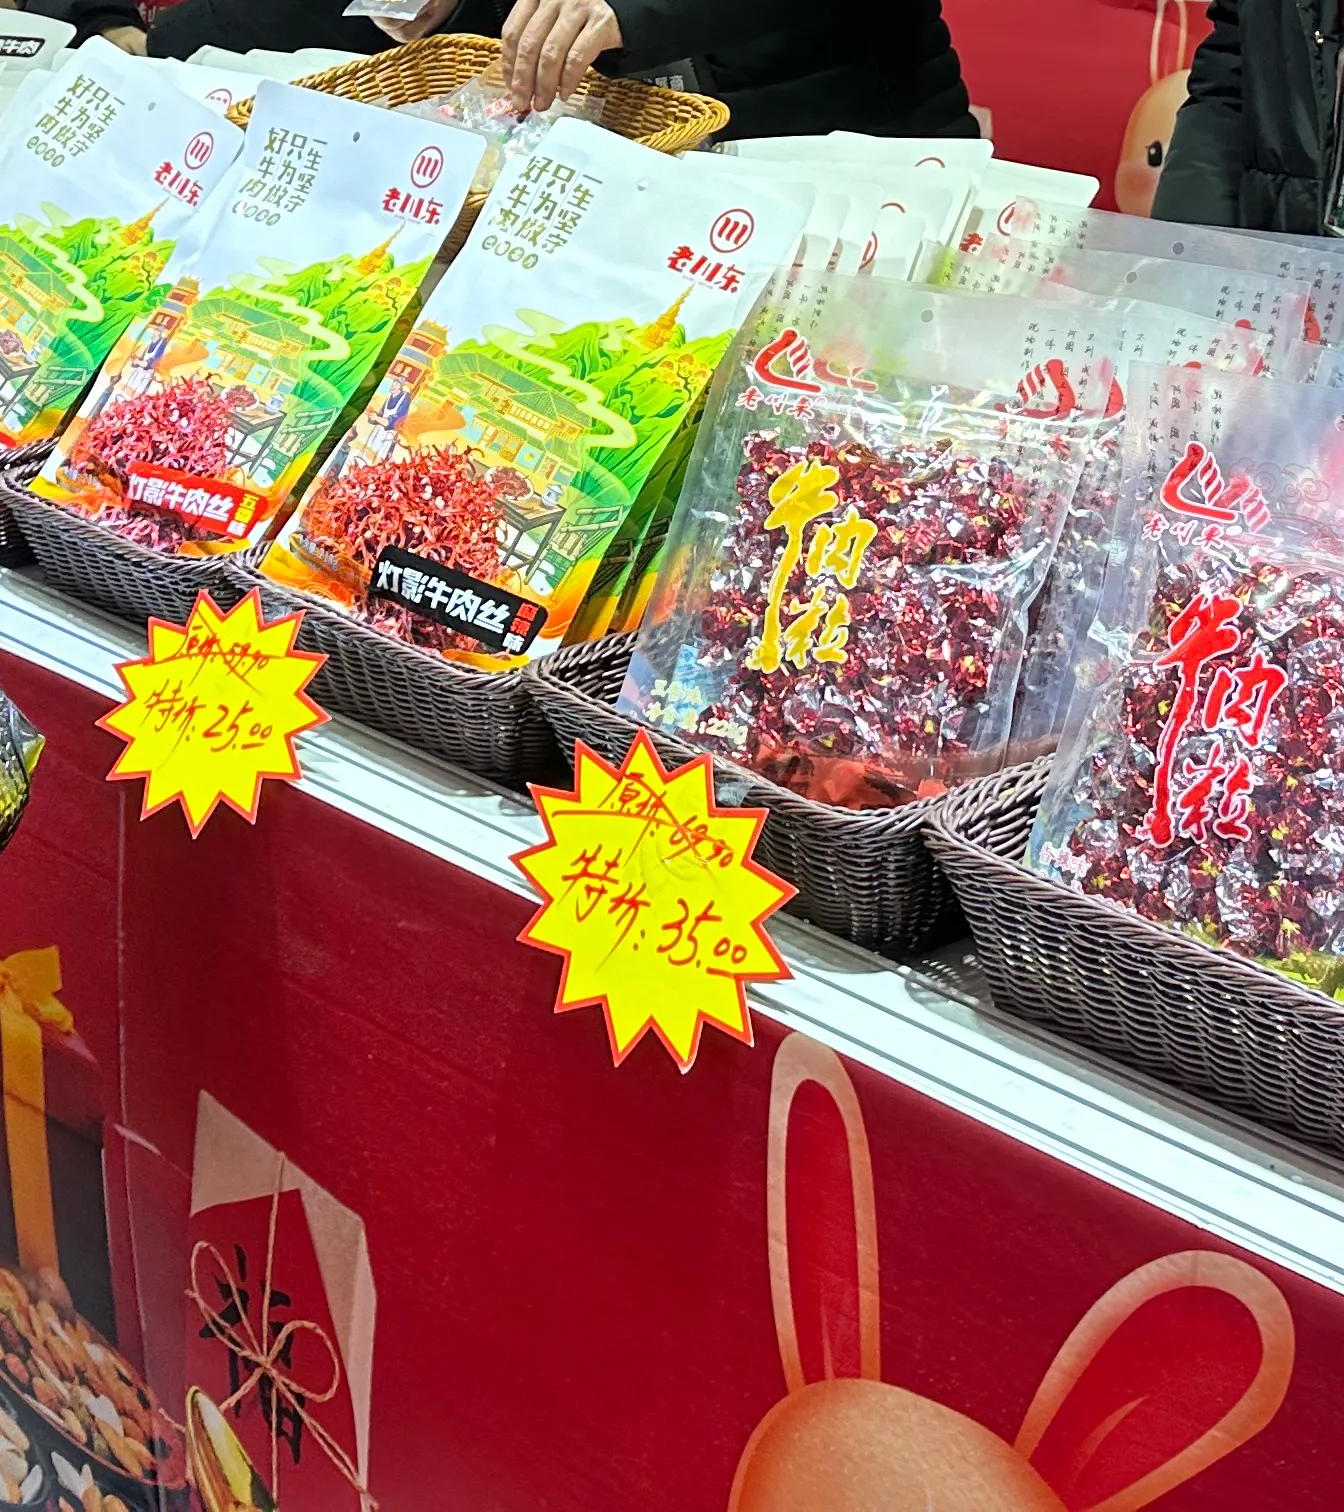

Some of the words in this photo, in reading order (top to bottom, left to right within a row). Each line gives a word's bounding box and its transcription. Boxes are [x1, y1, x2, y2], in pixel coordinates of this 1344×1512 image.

[153, 161, 205, 208] 老川东
[382, 186, 444, 225] 老川东
[667, 245, 746, 294] 老川东
[128, 471, 237, 523] 灯影牛肉丝
[748, 460, 879, 674] 牛肉粒
[375, 557, 511, 637] 灯影牛肉丝
[1134, 588, 1289, 851] 牛肉粒
